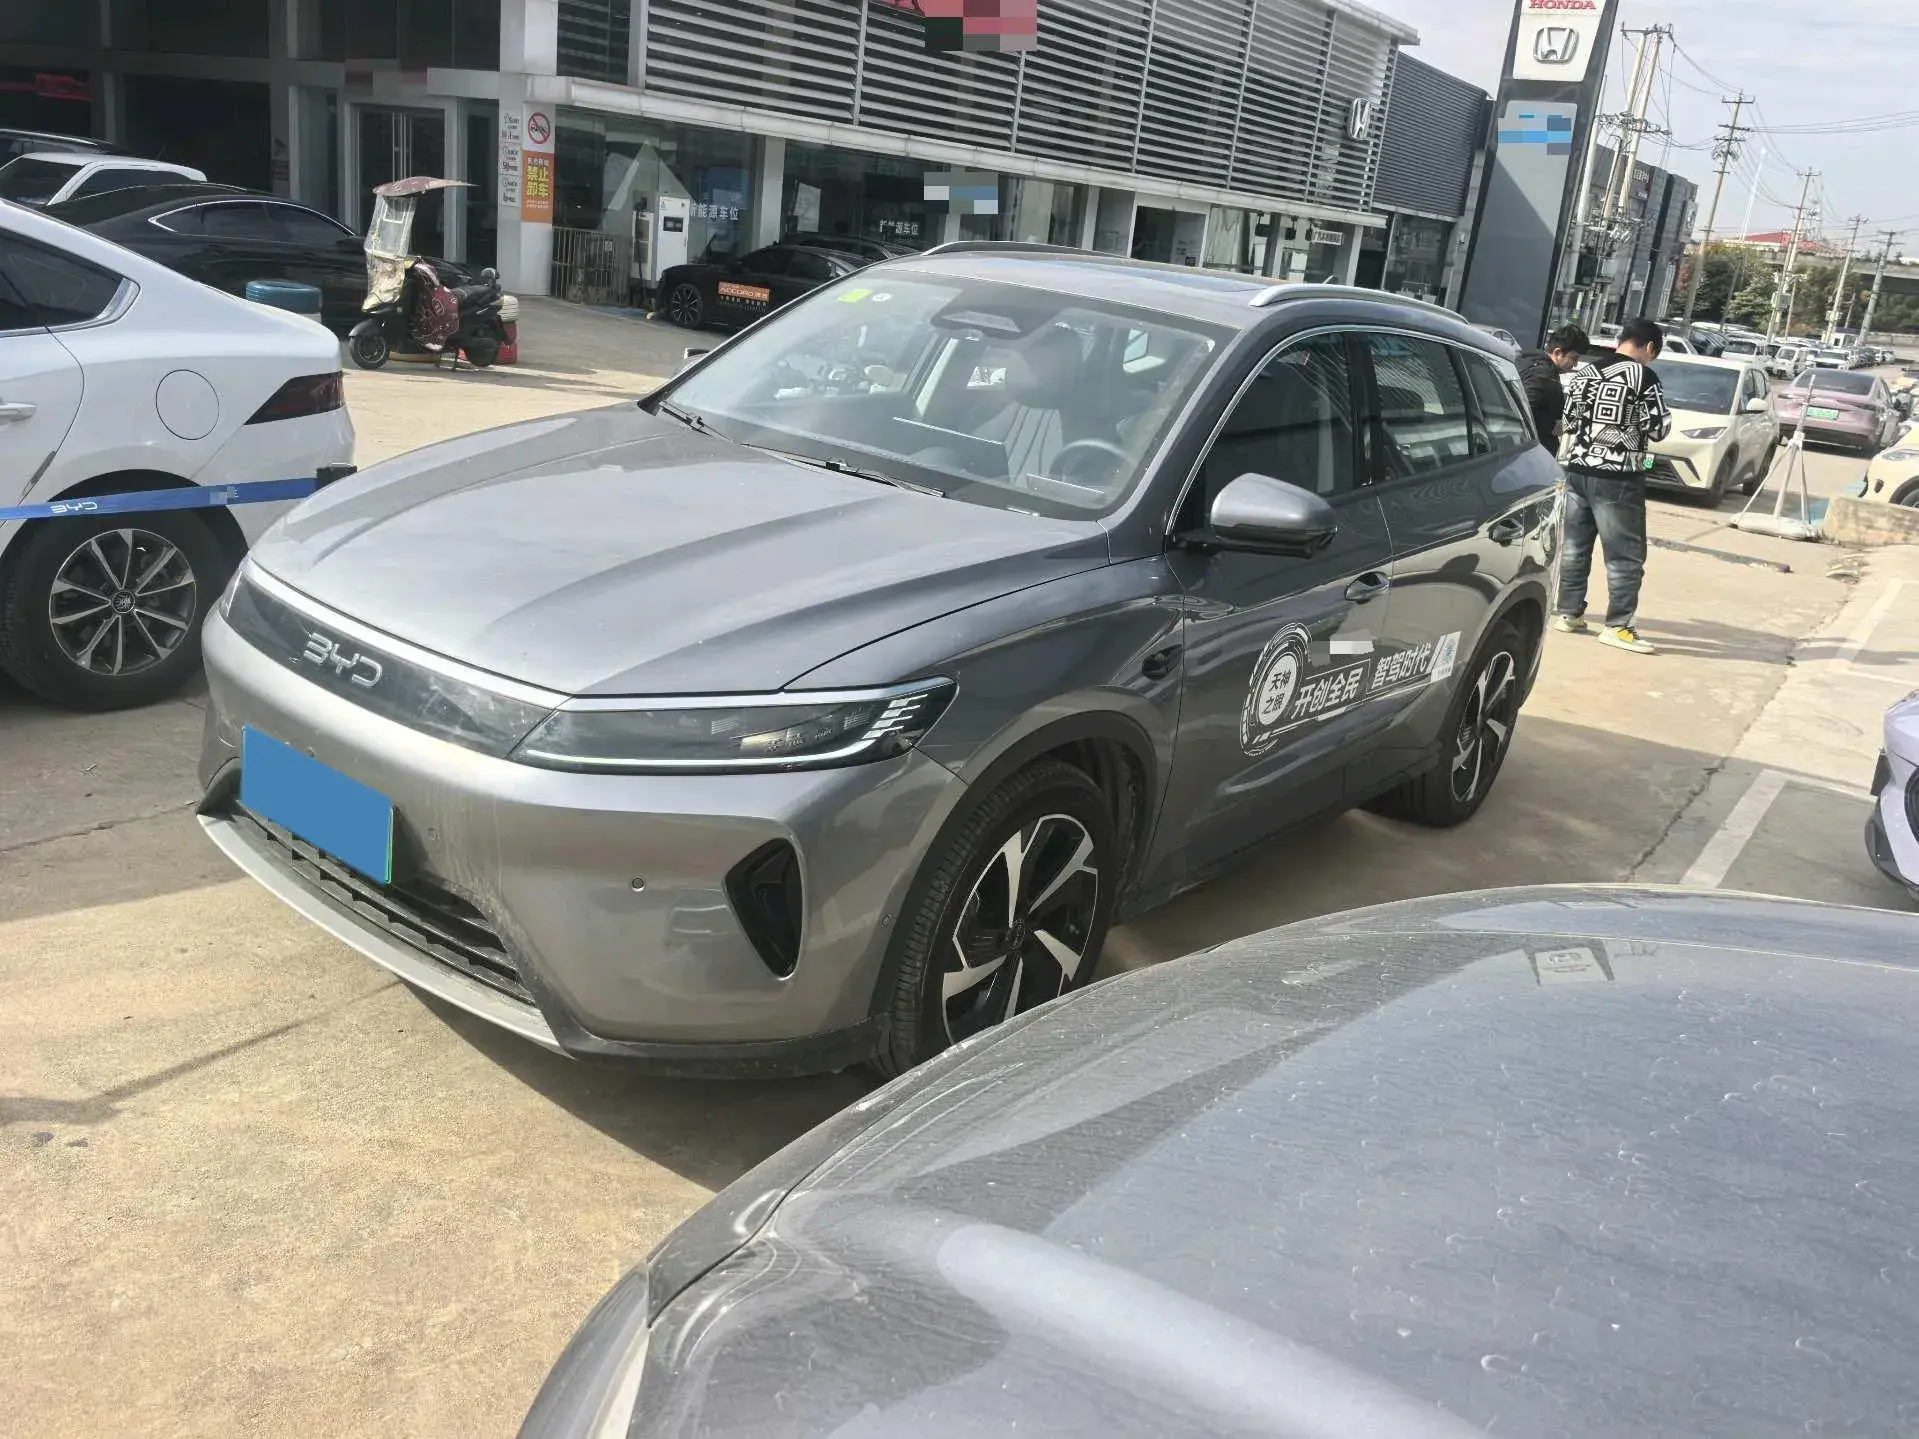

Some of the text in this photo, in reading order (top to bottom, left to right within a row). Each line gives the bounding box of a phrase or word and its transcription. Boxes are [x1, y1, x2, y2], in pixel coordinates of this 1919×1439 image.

[1529, 0, 1597, 9] HONDA
[50, 501, 98, 514] BYD
[303, 632, 383, 687] BYD
[1371, 642, 1431, 689] 智驾时代
[1268, 669, 1292, 692] 天神
[1262, 692, 1285, 715] 之眼
[1290, 667, 1364, 720] 开创全民
